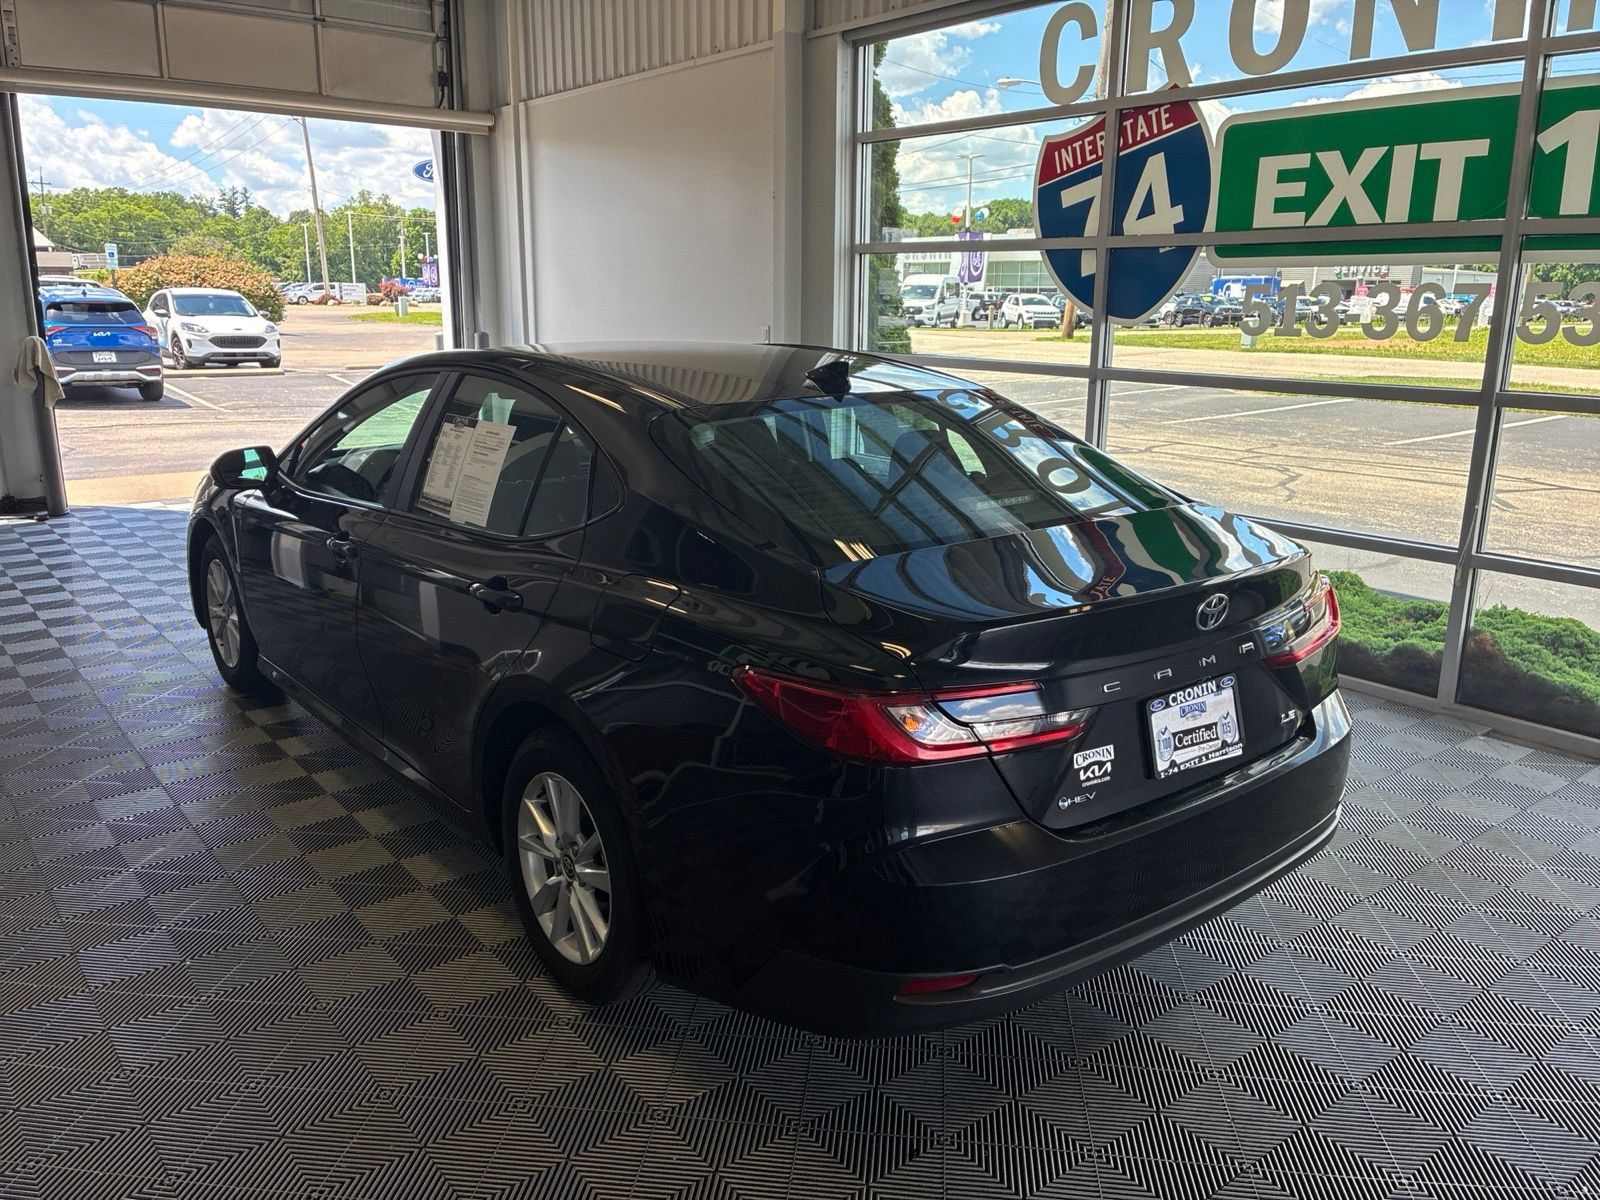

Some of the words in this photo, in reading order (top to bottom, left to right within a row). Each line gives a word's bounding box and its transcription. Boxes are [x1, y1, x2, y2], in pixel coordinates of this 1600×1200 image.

[1040, 0, 1596, 105] CRON
[1054, 104, 1174, 174] INTERTATE
[1252, 138, 1490, 229] EXIT
[1060, 151, 1184, 277] 74
[1168, 680, 1217, 706] CRONIN
[1180, 701, 1207, 717] CRONIN
[1280, 709, 1296, 724] LE
[1175, 725, 1217, 747] Certified
[1075, 746, 1112, 767] CRONIN
[1160, 766, 1179, 778] I-74
[1180, 758, 1201, 771] EXIT
[1209, 742, 1243, 759] Harrison
[1067, 791, 1096, 805] HEV
